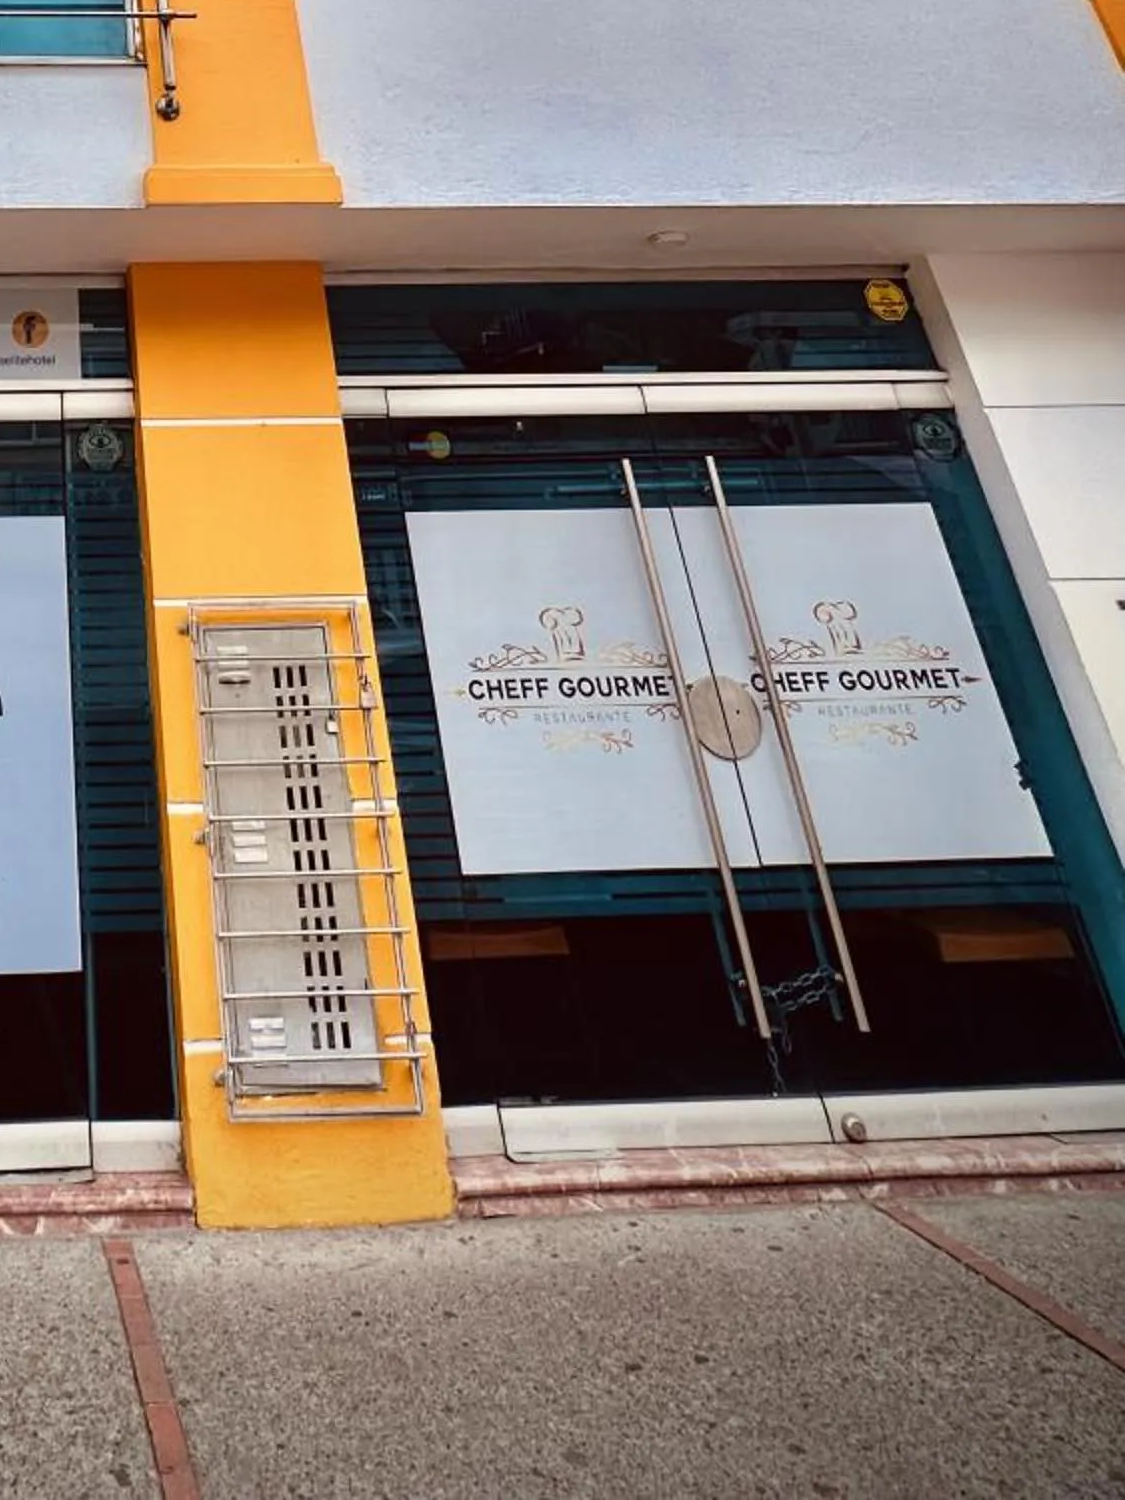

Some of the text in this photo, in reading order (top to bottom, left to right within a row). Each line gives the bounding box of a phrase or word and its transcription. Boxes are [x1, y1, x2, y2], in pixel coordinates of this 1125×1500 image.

[468, 678, 548, 700] CHEFF
[839, 668, 961, 691] GOURMET
[533, 710, 631, 726] RESTAURANTE
[818, 703, 914, 718] RESTAURANTE
